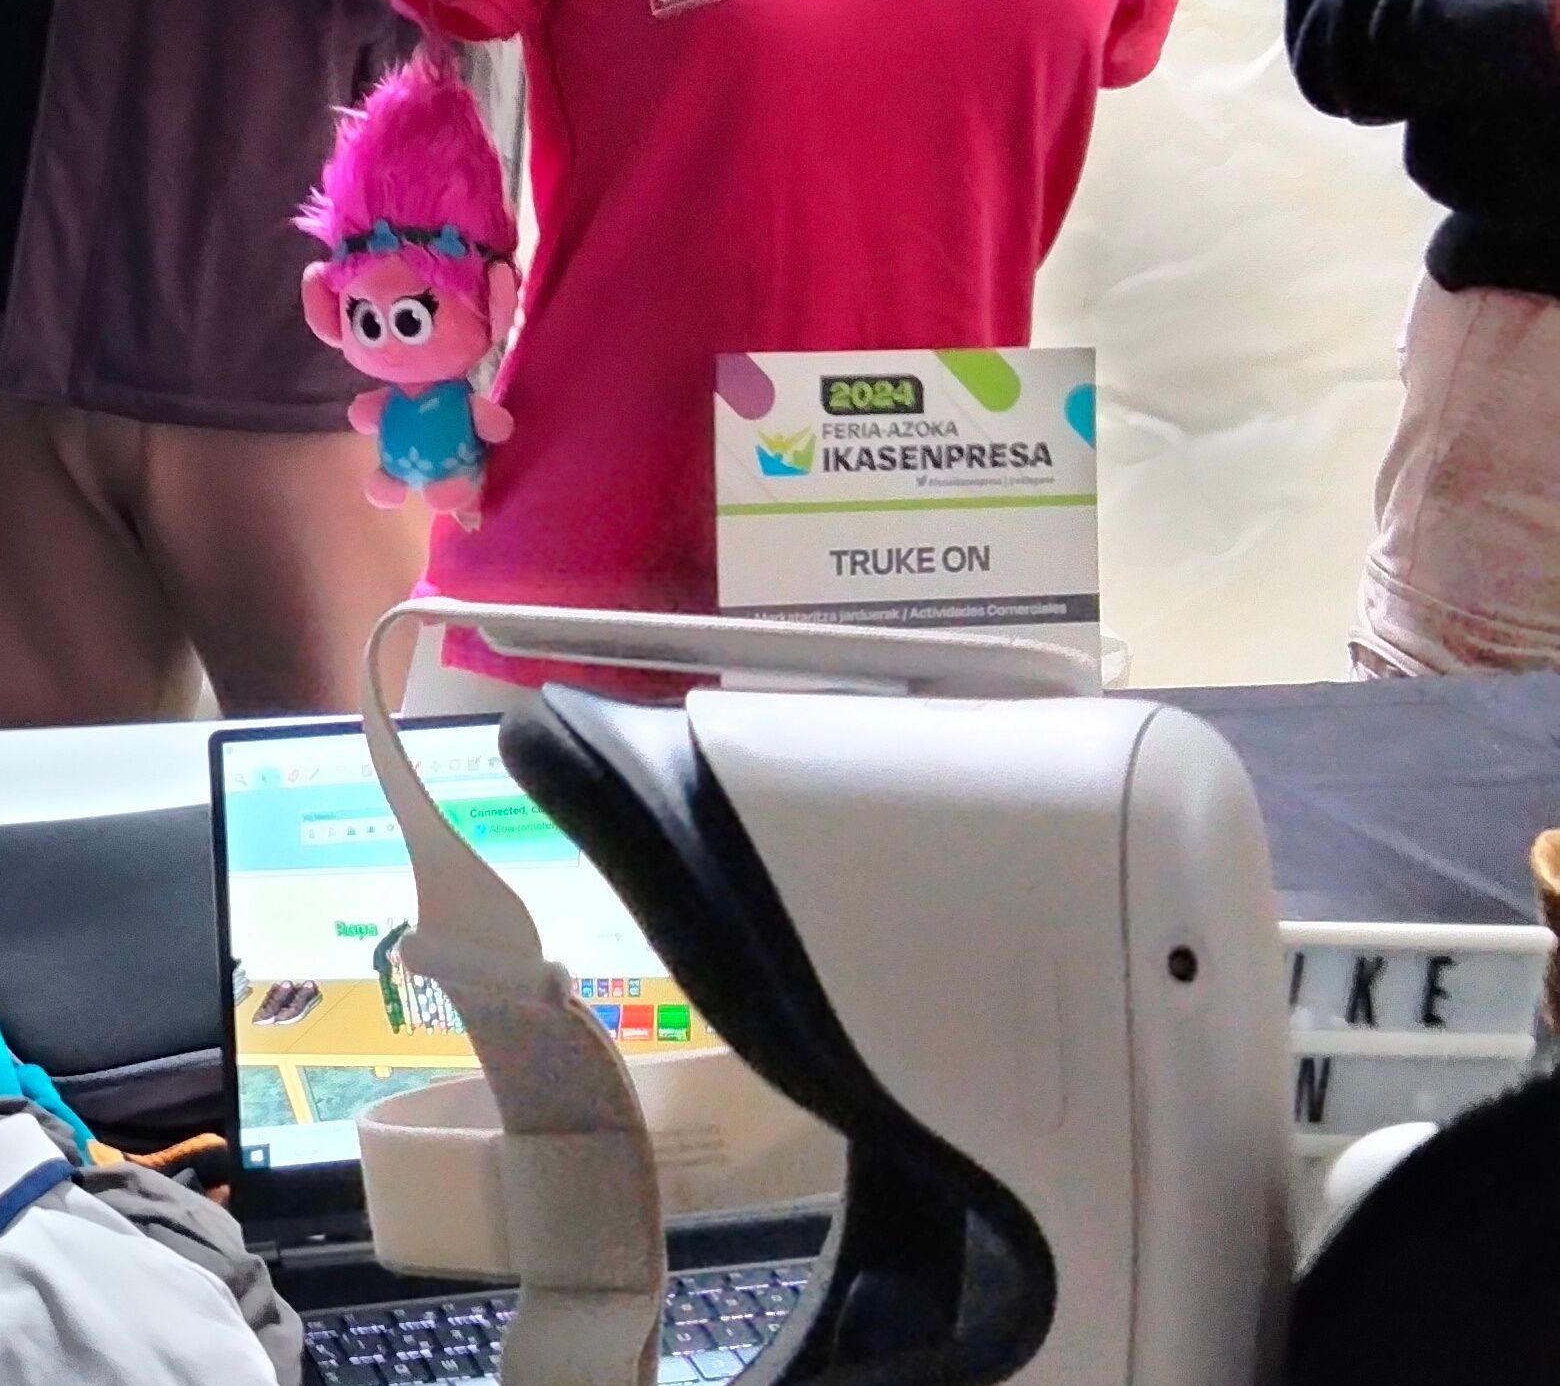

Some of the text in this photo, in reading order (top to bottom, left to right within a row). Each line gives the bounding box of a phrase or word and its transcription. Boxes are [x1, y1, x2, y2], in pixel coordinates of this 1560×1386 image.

[829, 380, 916, 408] 2024
[822, 420, 960, 440] FERIA-AZOKA
[822, 441, 1053, 473] IKASENPRESA
[829, 545, 991, 577] TRUKE ON
